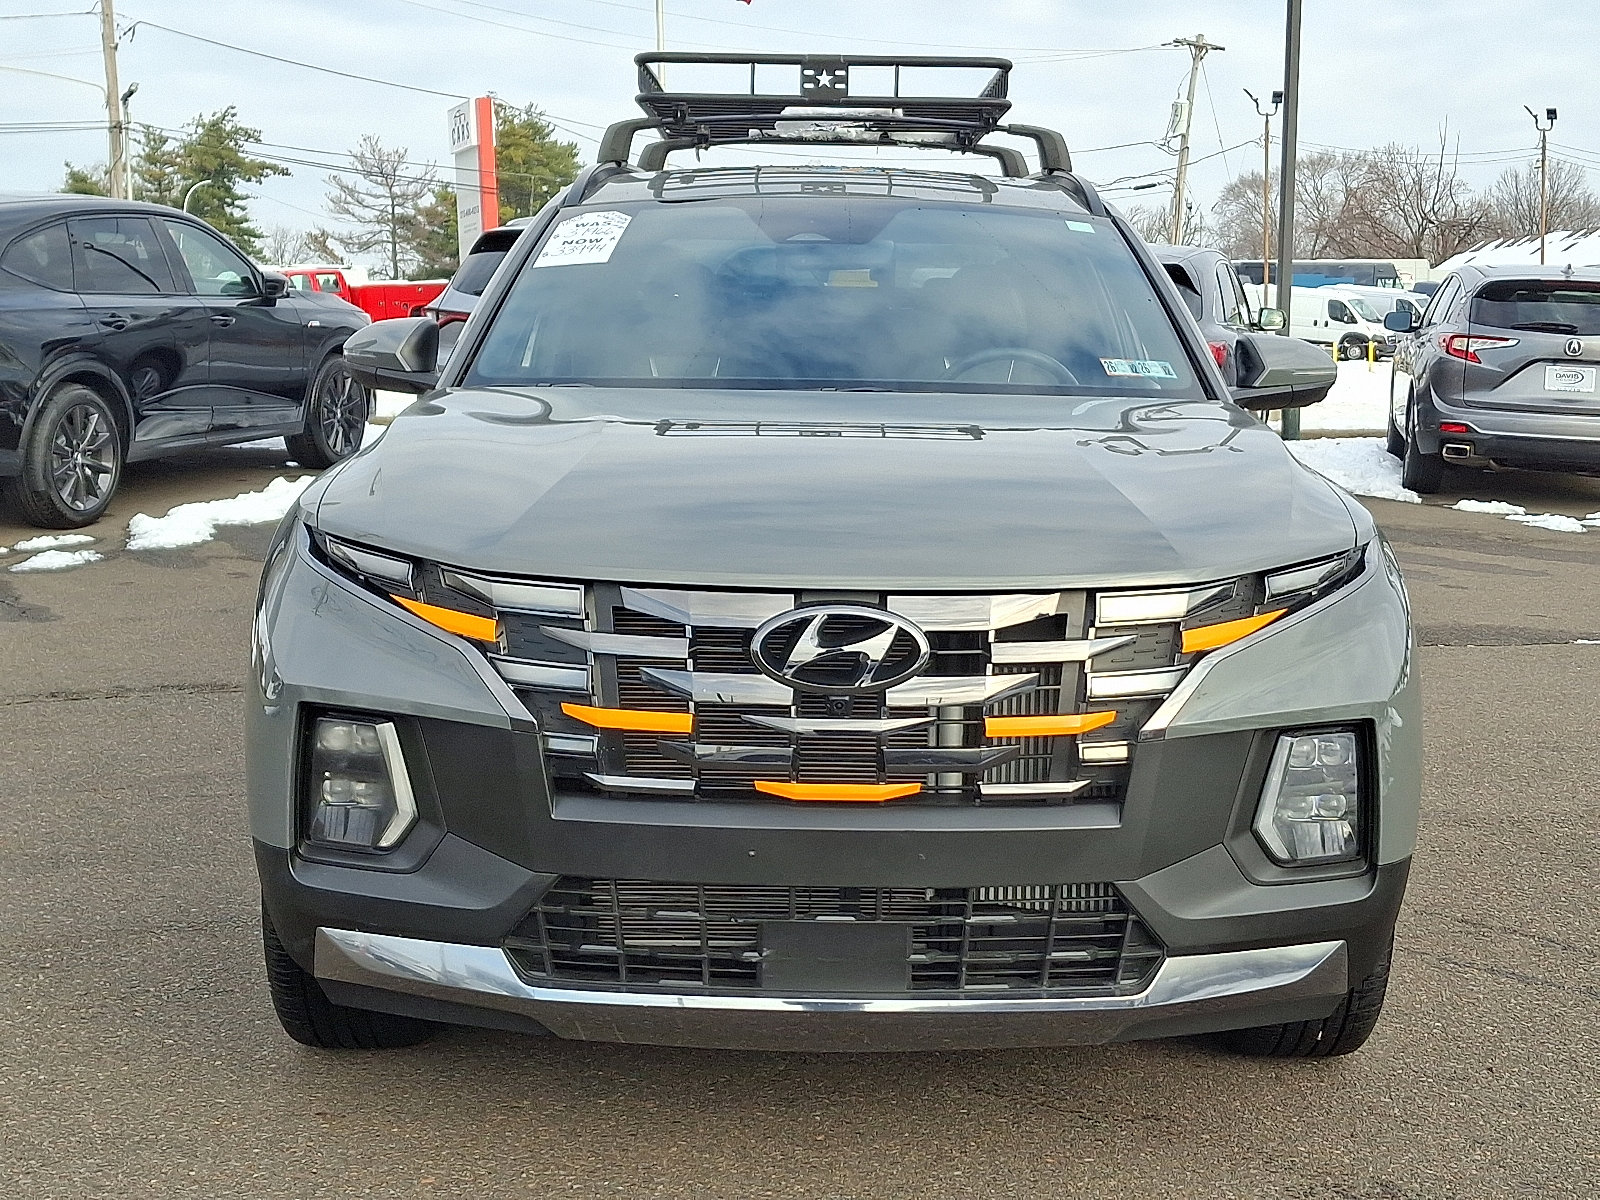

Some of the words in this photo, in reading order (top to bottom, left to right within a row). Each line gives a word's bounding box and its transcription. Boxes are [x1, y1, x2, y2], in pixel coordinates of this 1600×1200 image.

[452, 122, 470, 145] CARS
[1104, 361, 1116, 372] 26
[1138, 362, 1151, 374] 26
